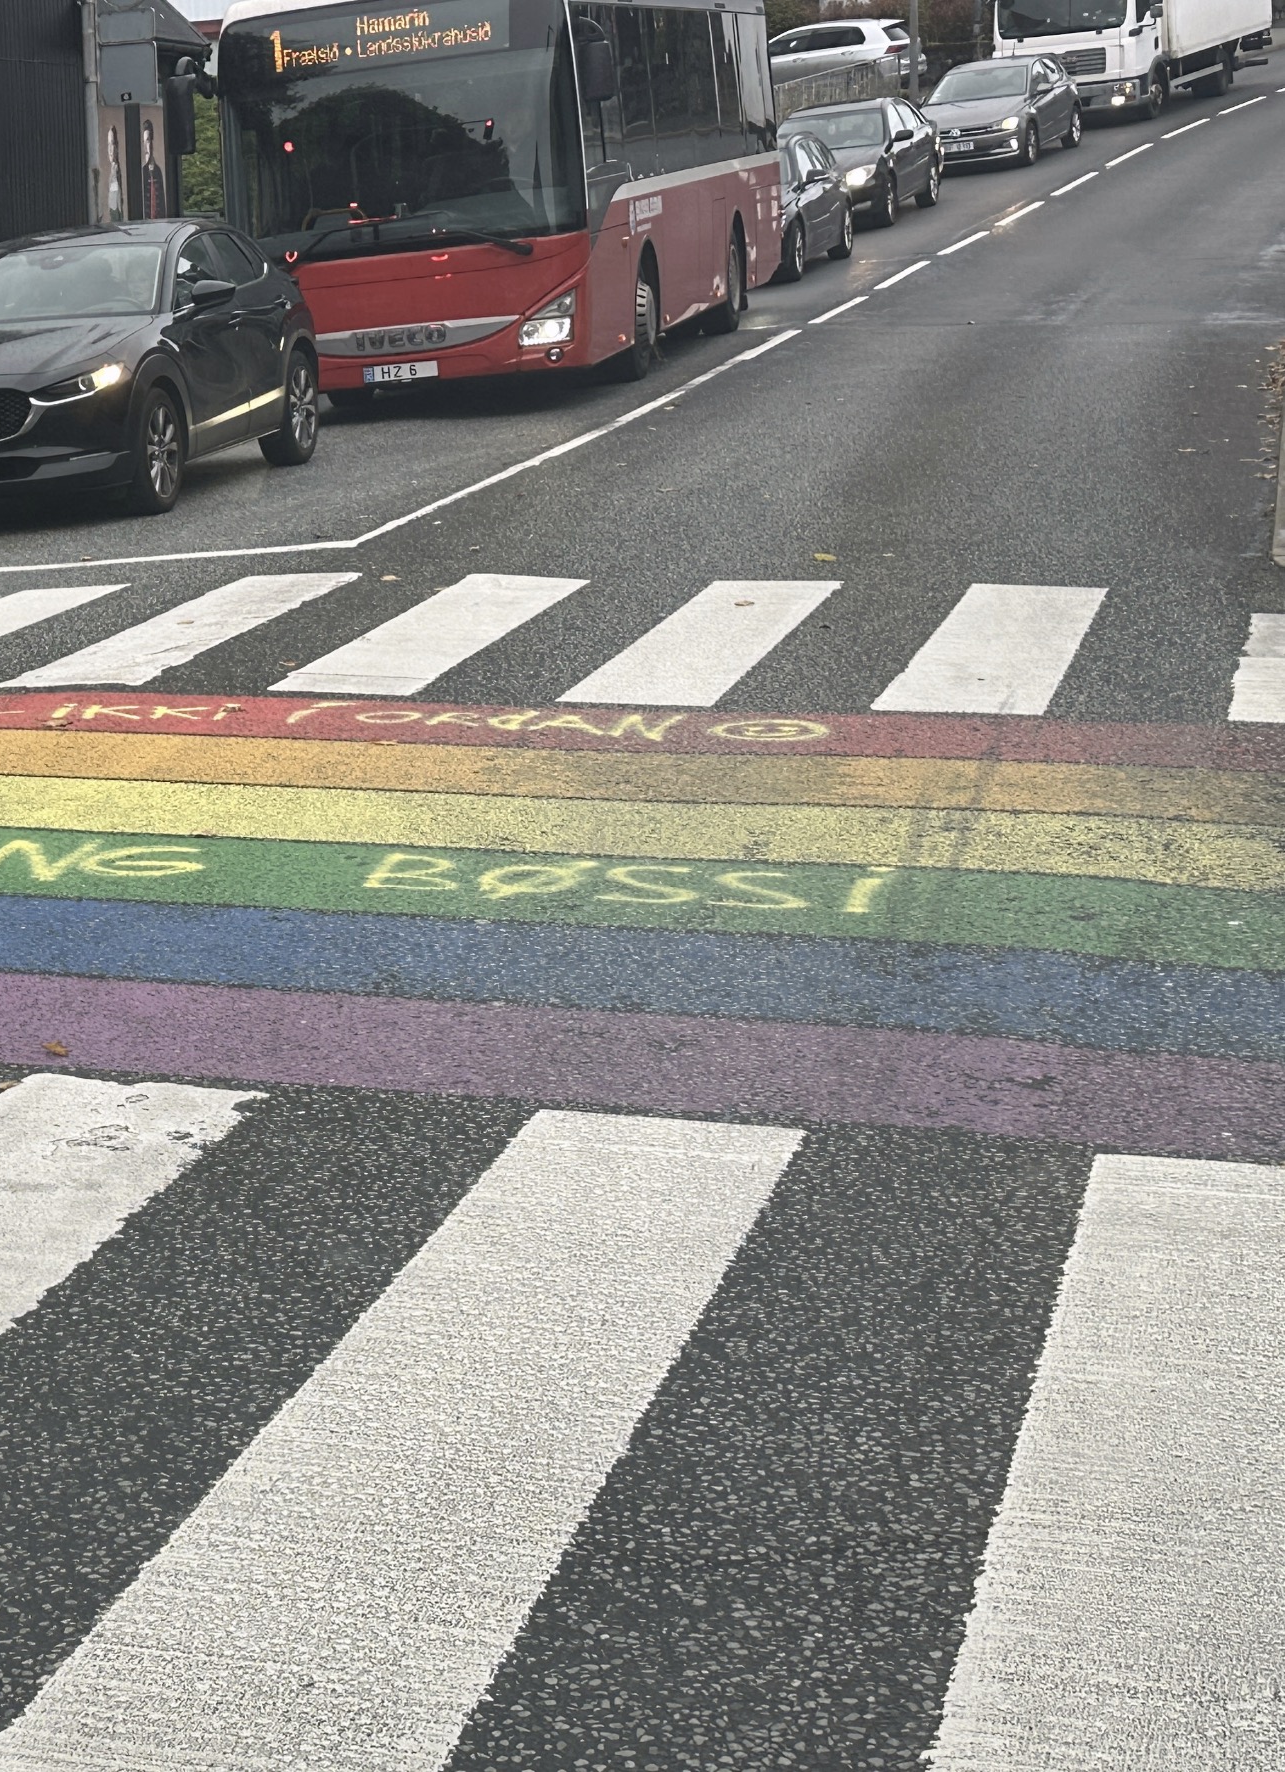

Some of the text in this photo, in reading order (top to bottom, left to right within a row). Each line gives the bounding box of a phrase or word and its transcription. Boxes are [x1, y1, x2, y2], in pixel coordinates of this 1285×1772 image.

[270, 30, 284, 73] 1
[355, 324, 446, 352] IVECO
[381, 364, 418, 379] HZ 6
